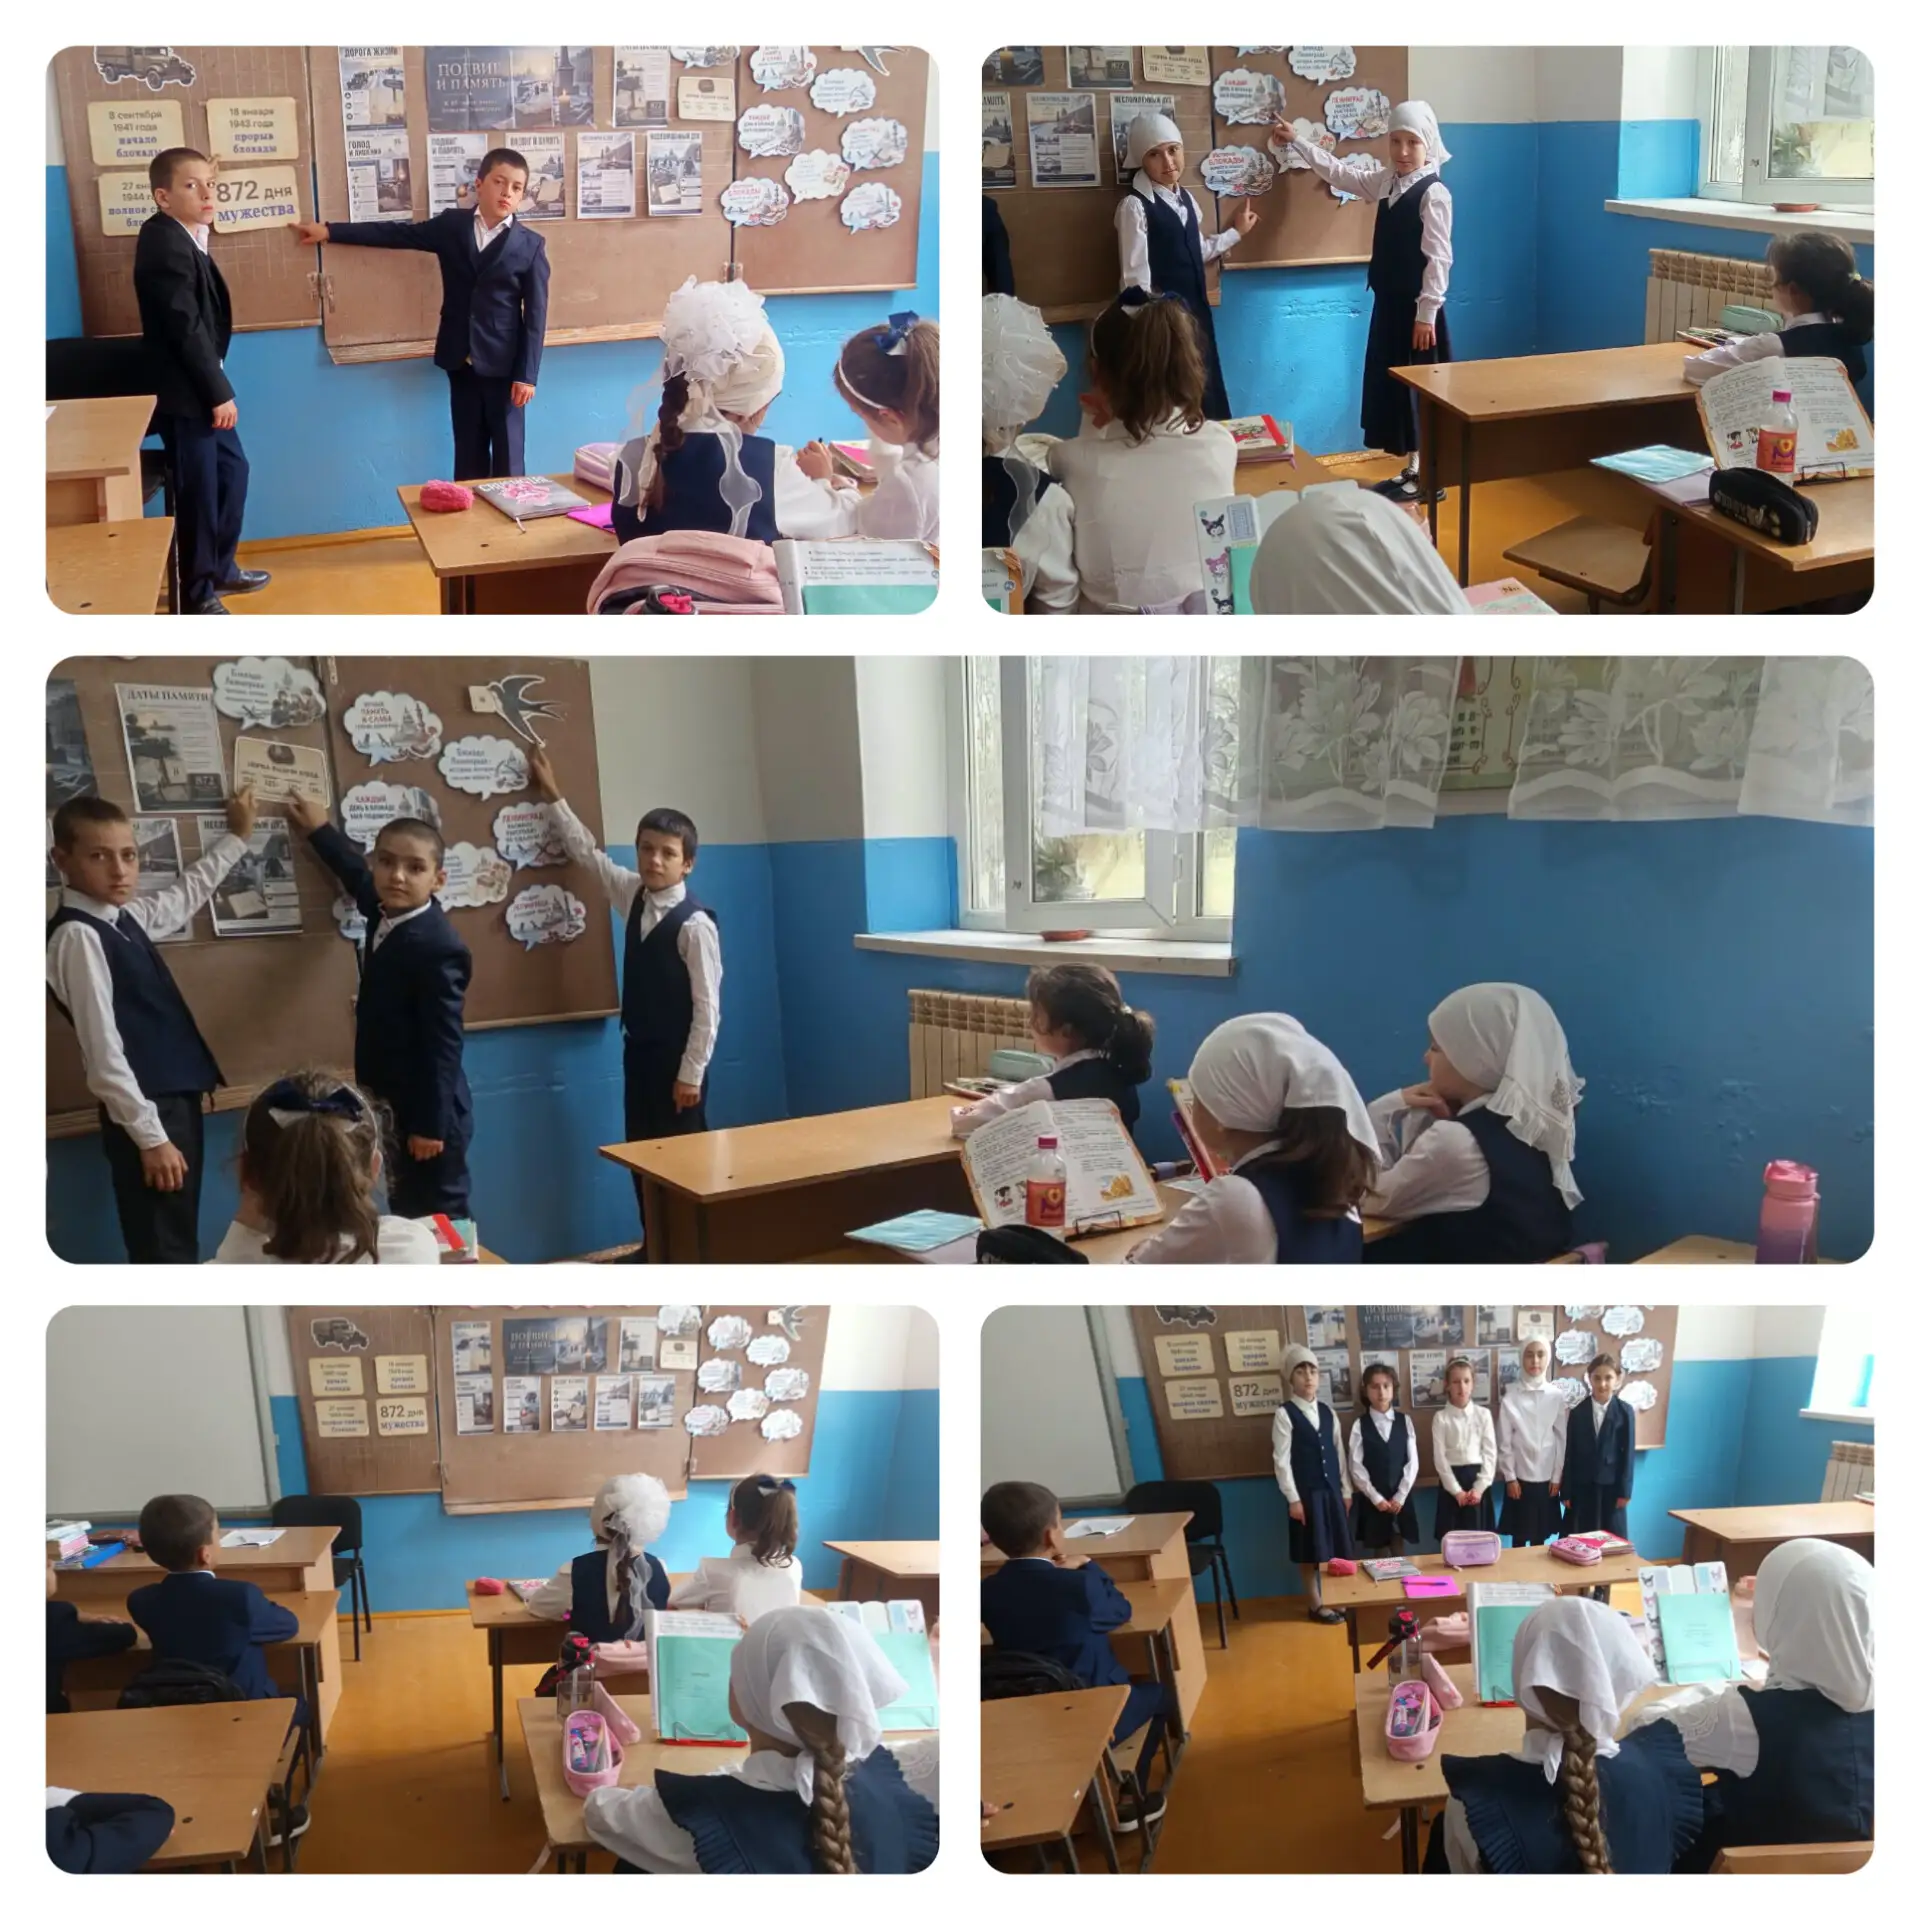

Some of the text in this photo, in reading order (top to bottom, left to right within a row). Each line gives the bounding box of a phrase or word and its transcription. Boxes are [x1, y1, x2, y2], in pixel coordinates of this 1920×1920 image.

[438, 63, 500, 77] ПОДВИГ
[436, 78, 507, 91] И ПАМЯТЬ
[113, 123, 133, 132] 1941
[118, 136, 158, 145] начало
[234, 133, 274, 142] прорыв
[348, 141, 371, 149] ГОЛОД
[121, 182, 134, 191] 27
[216, 180, 293, 203] 872 дня
[108, 207, 147, 216] полное
[217, 203, 296, 224] мужества
[127, 690, 159, 700] ДАТЫ
[1234, 1384, 1260, 1397] 872
[380, 1405, 404, 1418] 872
[381, 1420, 425, 1431] мужества
